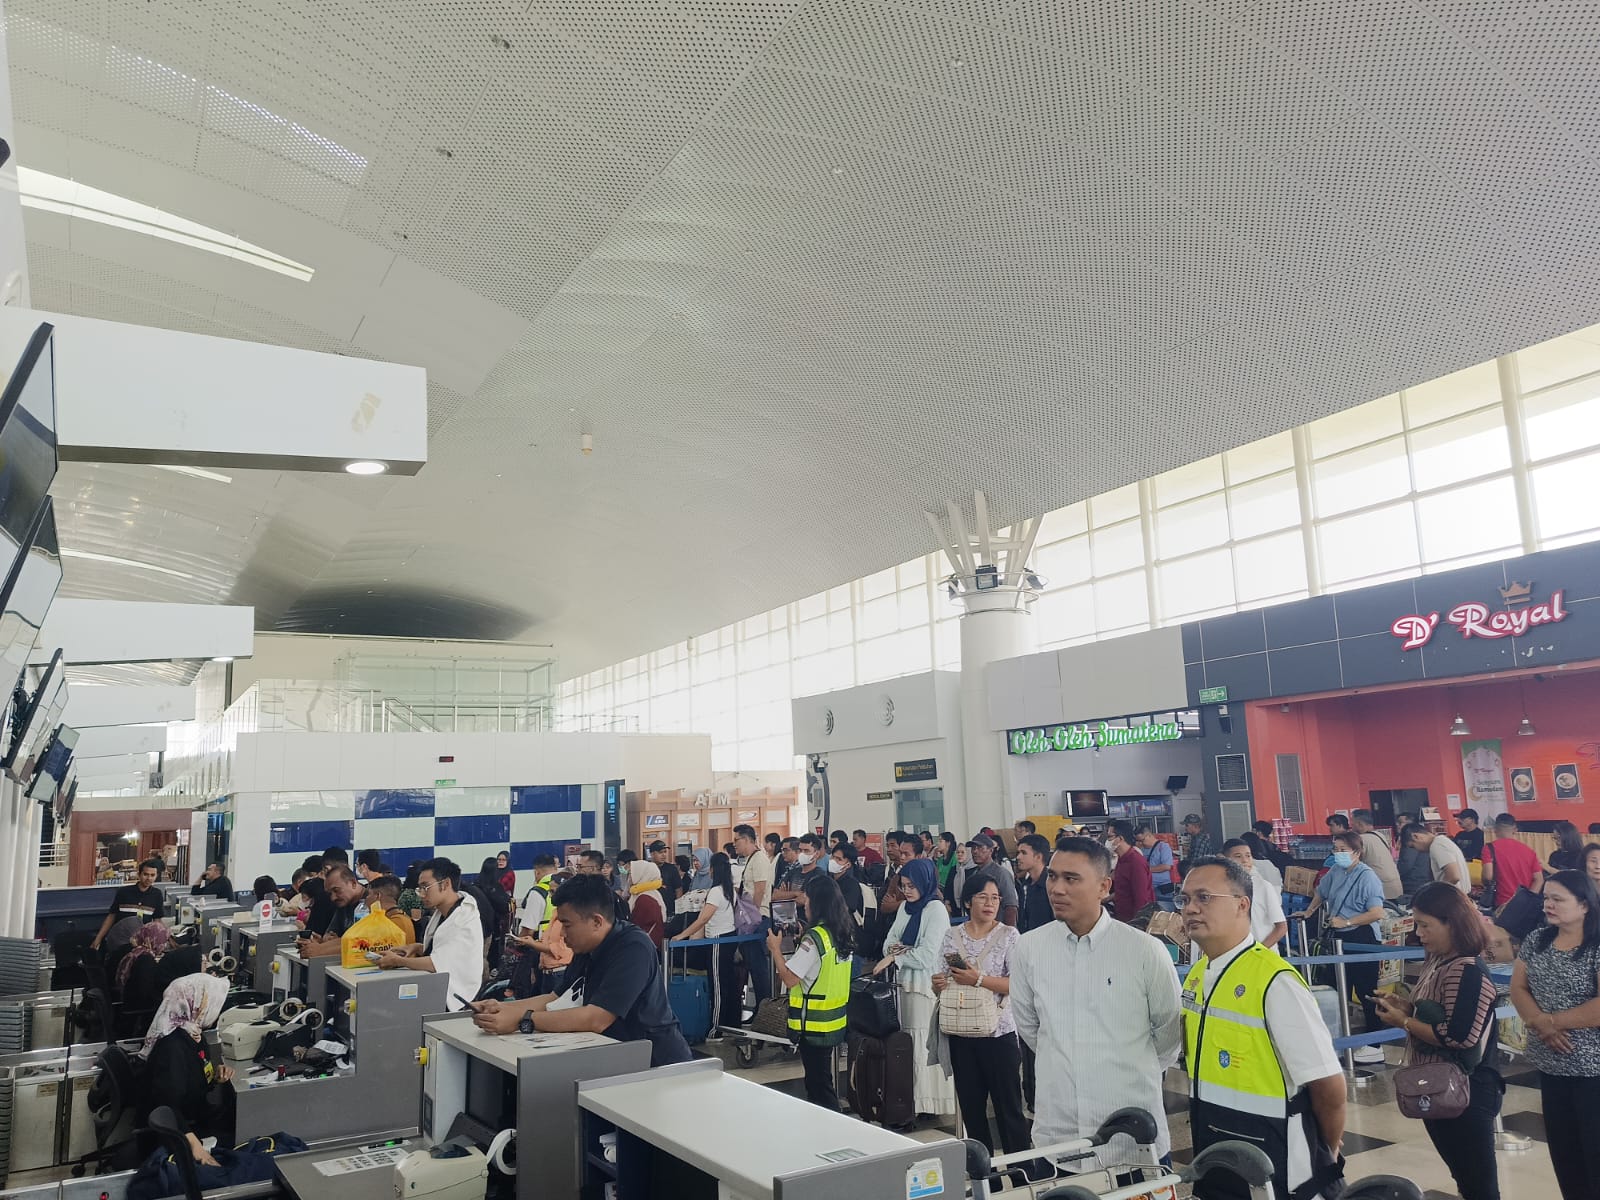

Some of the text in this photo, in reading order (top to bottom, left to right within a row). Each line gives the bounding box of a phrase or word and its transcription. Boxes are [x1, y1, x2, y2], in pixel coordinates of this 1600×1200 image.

[1392, 590, 1566, 650] D' Royal
[1011, 721, 1182, 754] Oleh-Oleh Sumatera
[694, 792, 730, 808] ATM
